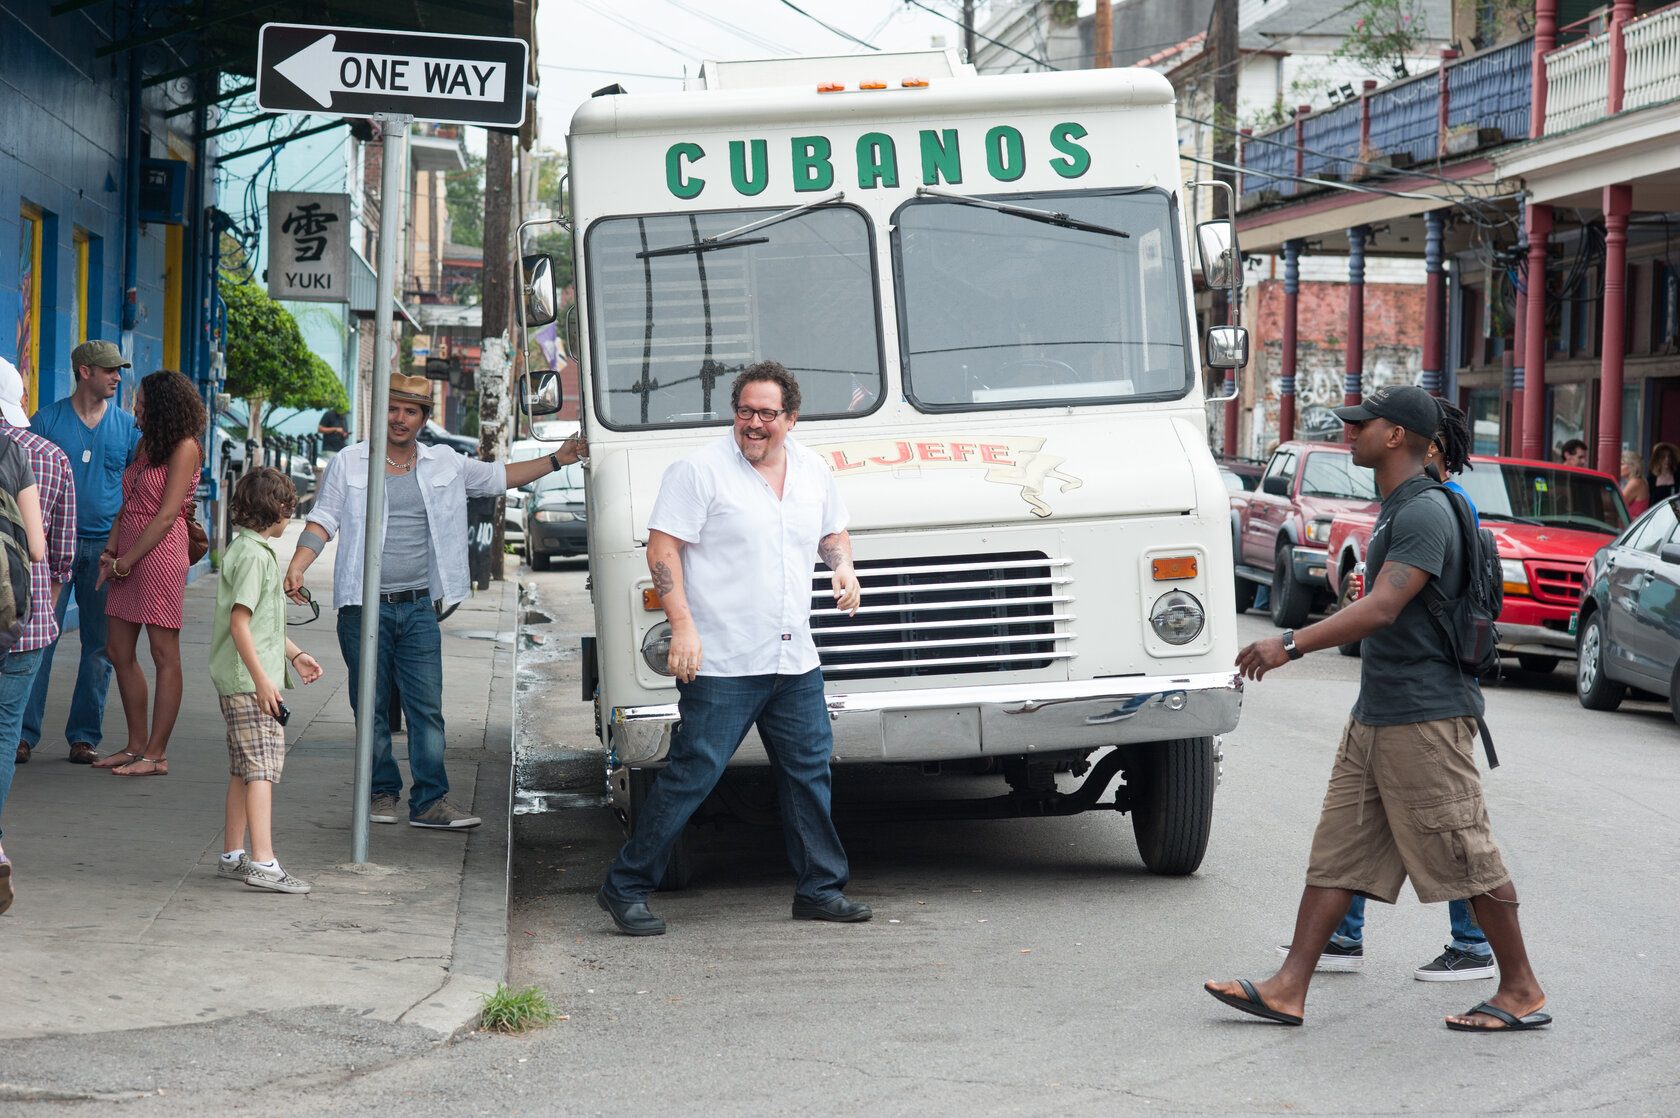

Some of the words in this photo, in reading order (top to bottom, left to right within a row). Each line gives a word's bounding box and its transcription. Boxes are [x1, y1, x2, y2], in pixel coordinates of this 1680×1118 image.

[340, 56, 409, 92] ONE
[424, 61, 496, 97] WAY
[665, 121, 1091, 200] CUBANOS
[282, 203, 339, 262] 雪
[285, 272, 331, 289] YUKI
[869, 441, 1017, 467] JEFE
